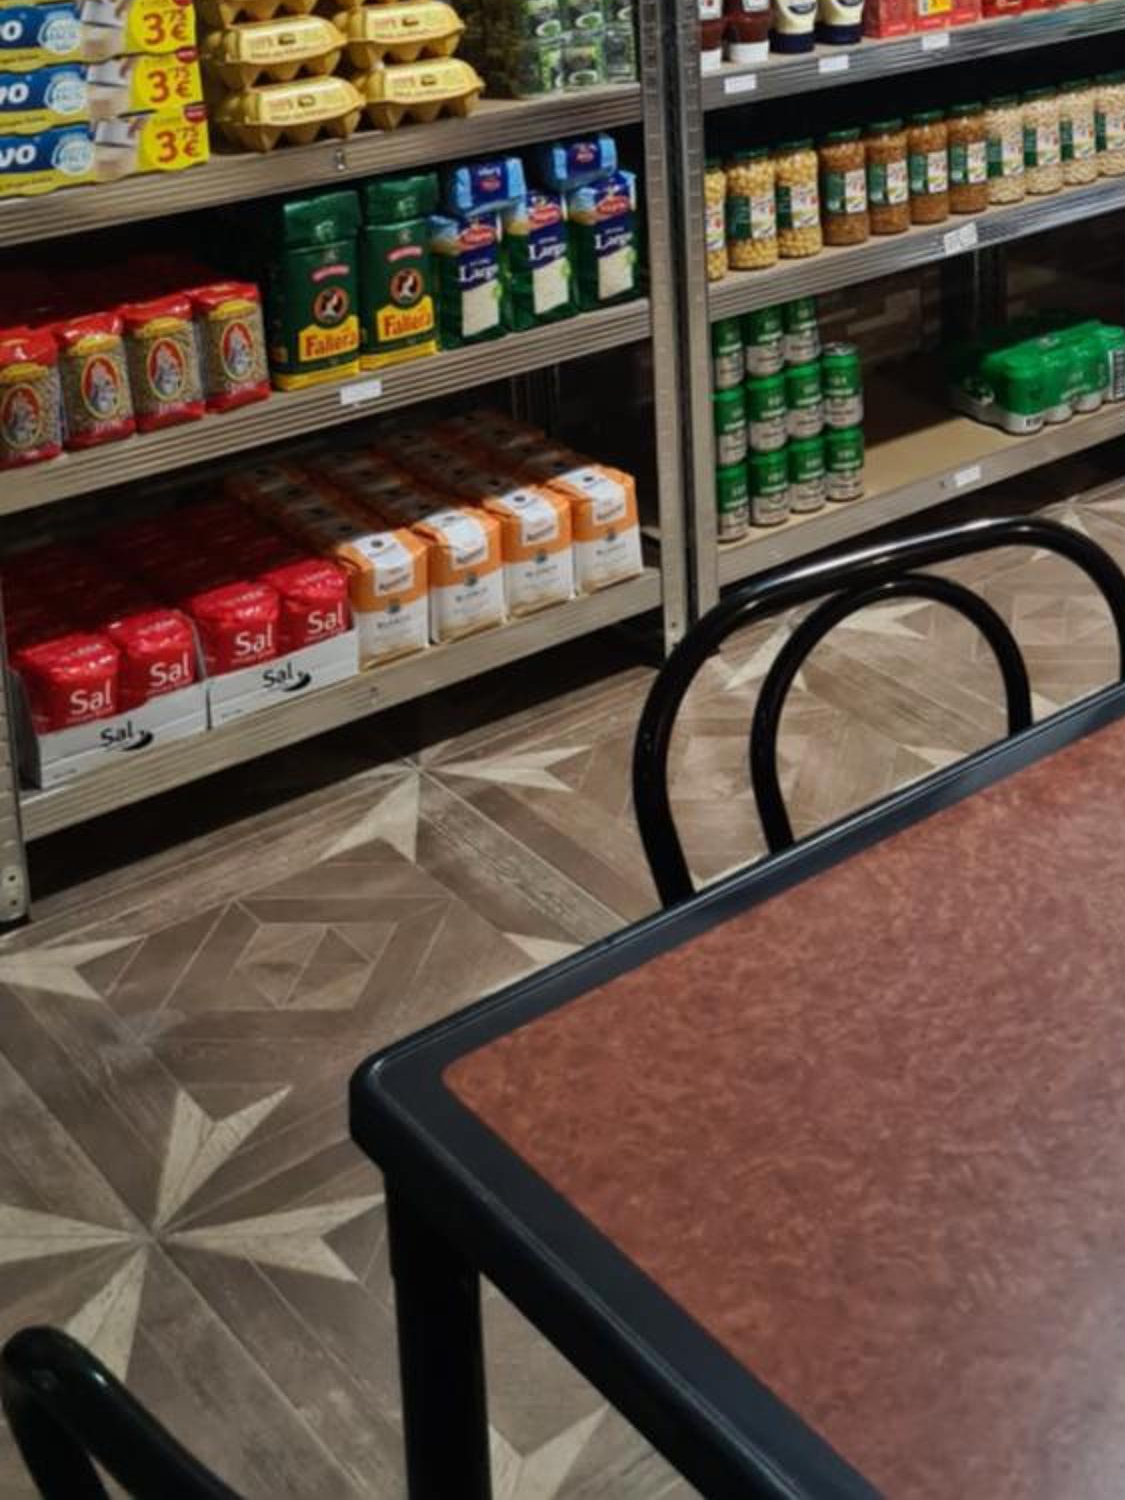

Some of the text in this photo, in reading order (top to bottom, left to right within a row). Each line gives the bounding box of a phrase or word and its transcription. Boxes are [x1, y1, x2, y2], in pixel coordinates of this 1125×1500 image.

[143, 12, 165, 46] 3
[147, 70, 170, 104] 3
[155, 130, 178, 164] 3
[308, 602, 344, 636] Sal
[235, 622, 274, 657] Sal
[151, 652, 190, 687] Sal
[262, 663, 293, 689] Sal
[70, 681, 112, 715] Sal
[101, 721, 134, 748] Sal
